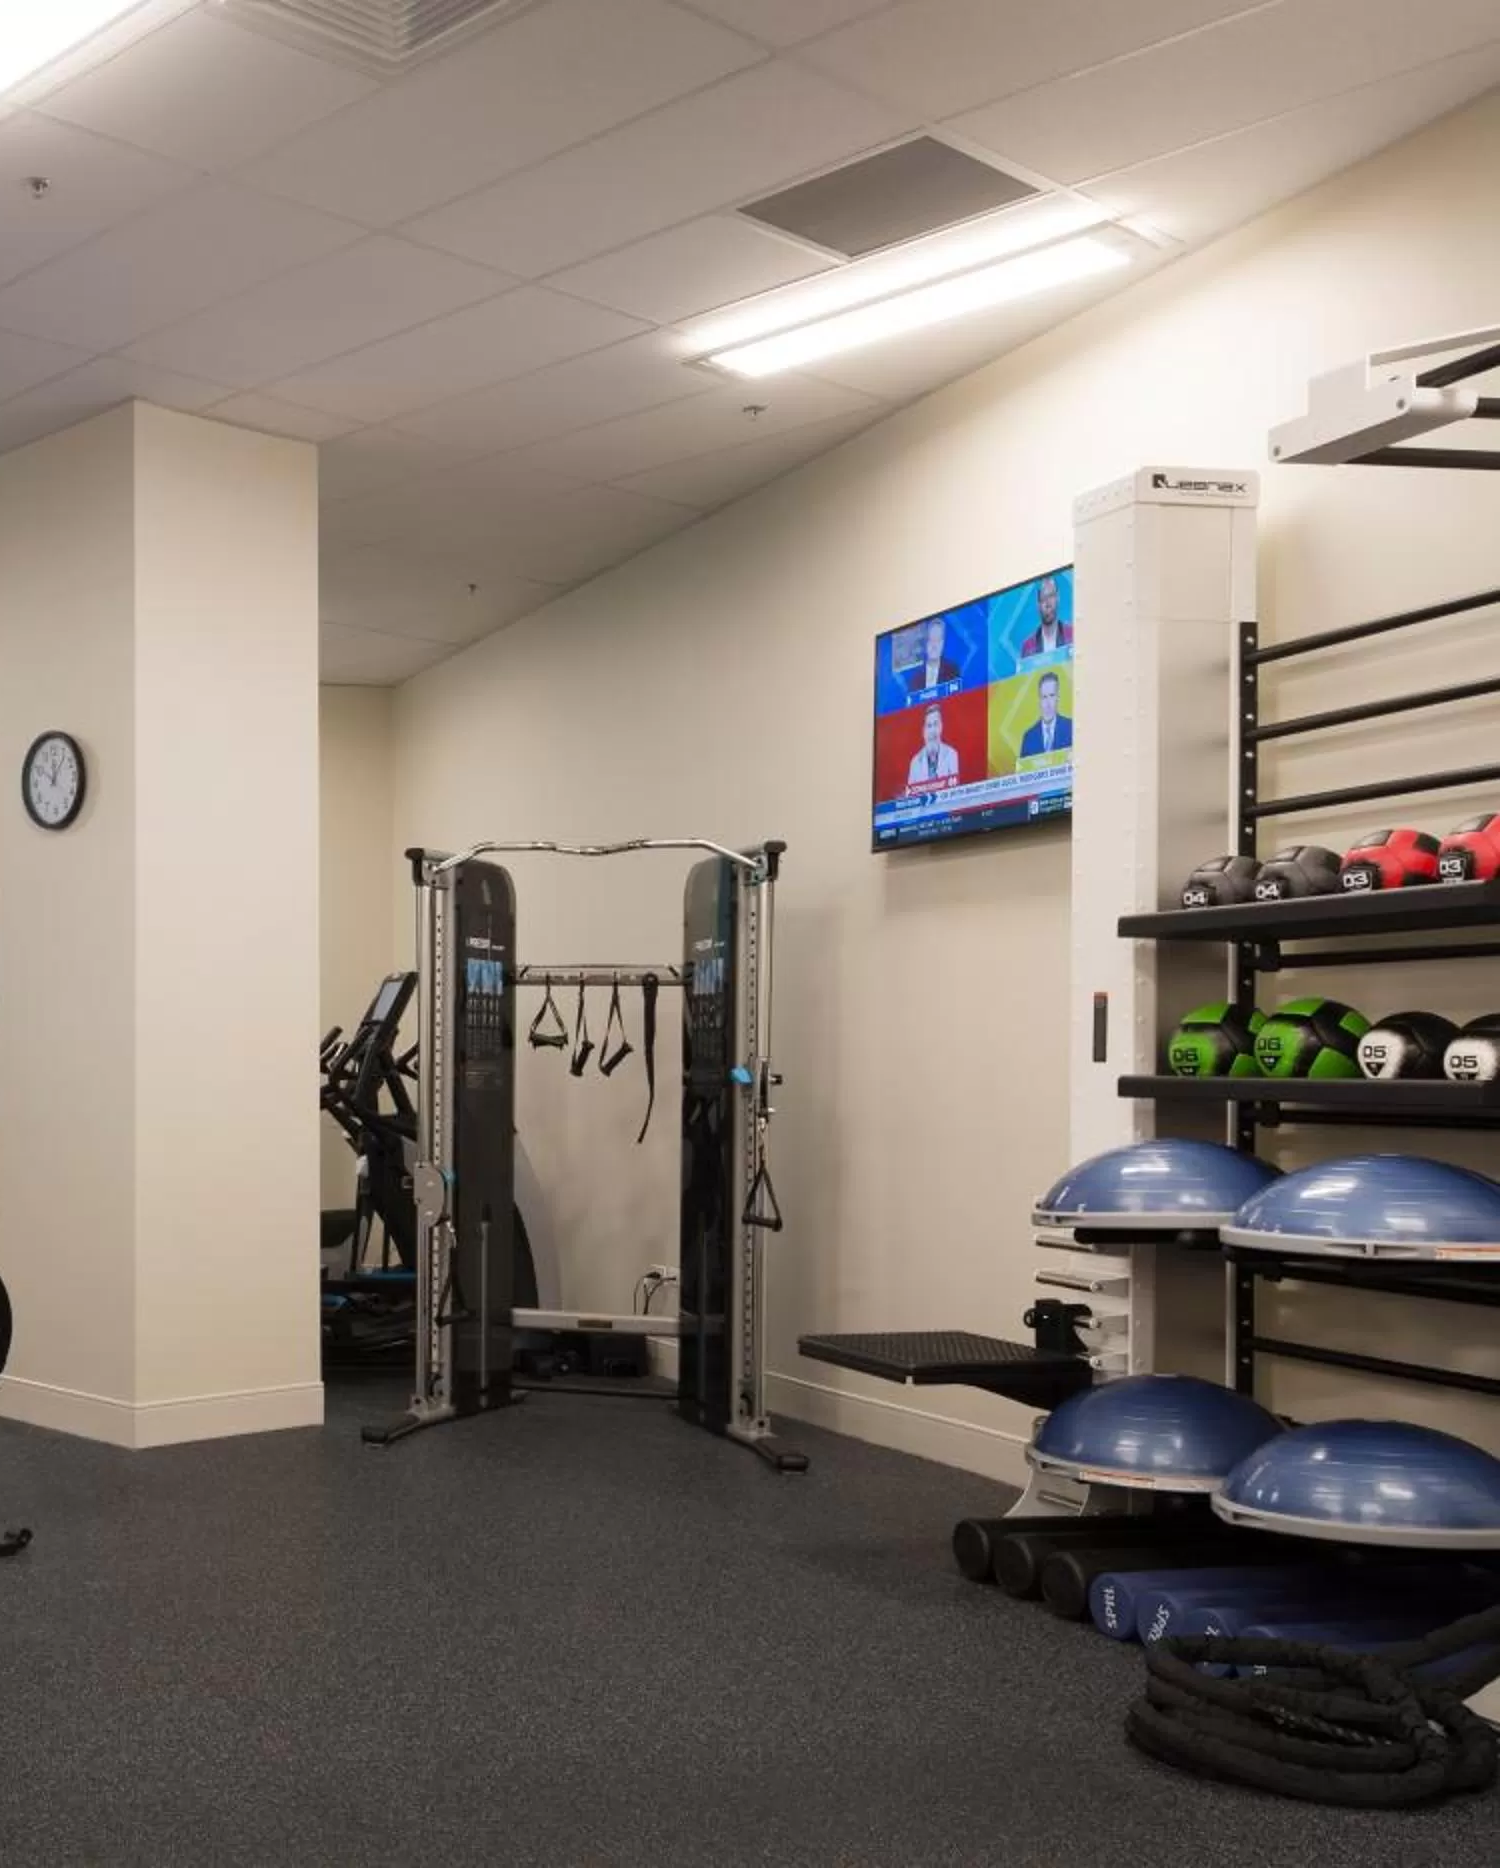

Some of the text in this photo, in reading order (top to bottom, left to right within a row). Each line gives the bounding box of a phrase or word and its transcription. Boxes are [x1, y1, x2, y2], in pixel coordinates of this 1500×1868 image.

[1439, 859, 1461, 875] 03
[1343, 872, 1369, 889] 03
[1256, 883, 1280, 899] 04
[1256, 1036, 1281, 1051] 06
[1173, 1048, 1199, 1064] 06
[1363, 1045, 1387, 1059] 05
[1450, 1055, 1478, 1069] 05
